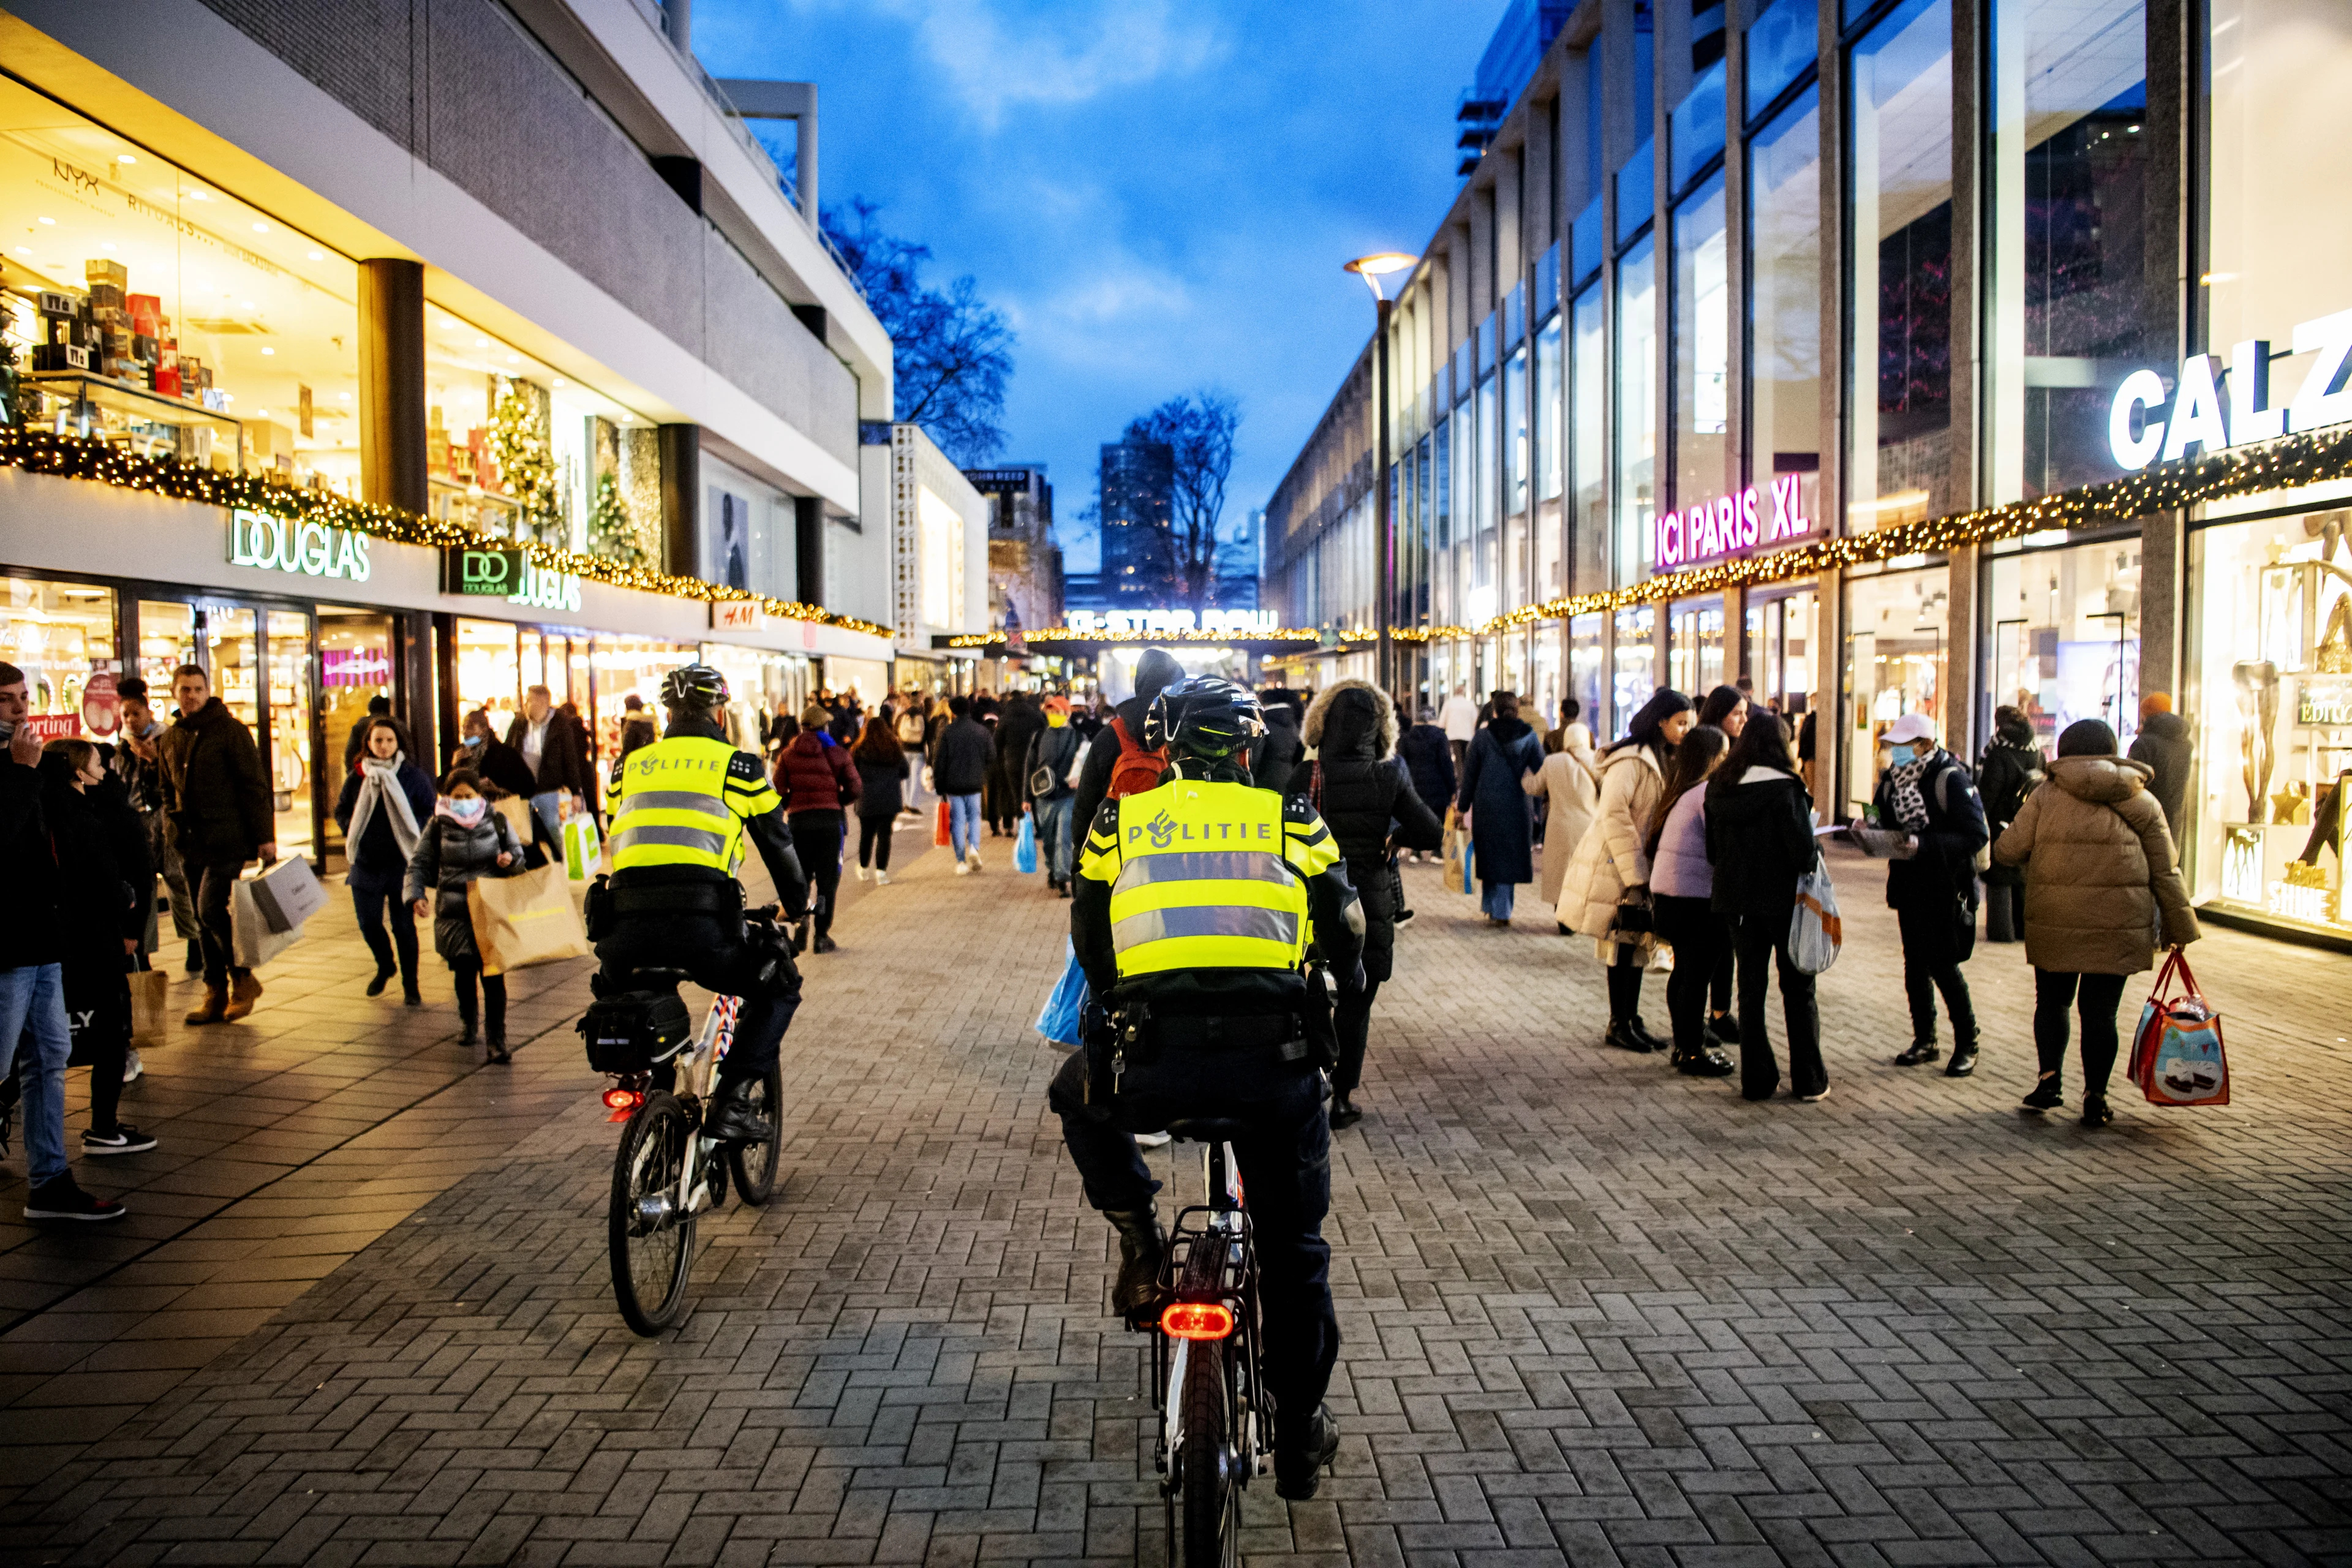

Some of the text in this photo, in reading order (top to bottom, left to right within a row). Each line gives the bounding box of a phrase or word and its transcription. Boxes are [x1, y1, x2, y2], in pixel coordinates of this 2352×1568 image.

[53, 157, 99, 196] NYX
[1656, 472, 1810, 567] ICI PARIS XL
[232, 508, 370, 582] DOUGLAS
[1201, 609, 1278, 634] RAW
[29, 715, 74, 736] orting
[628, 753, 720, 775] POLITIE
[1128, 810, 1271, 848] POLITIE
